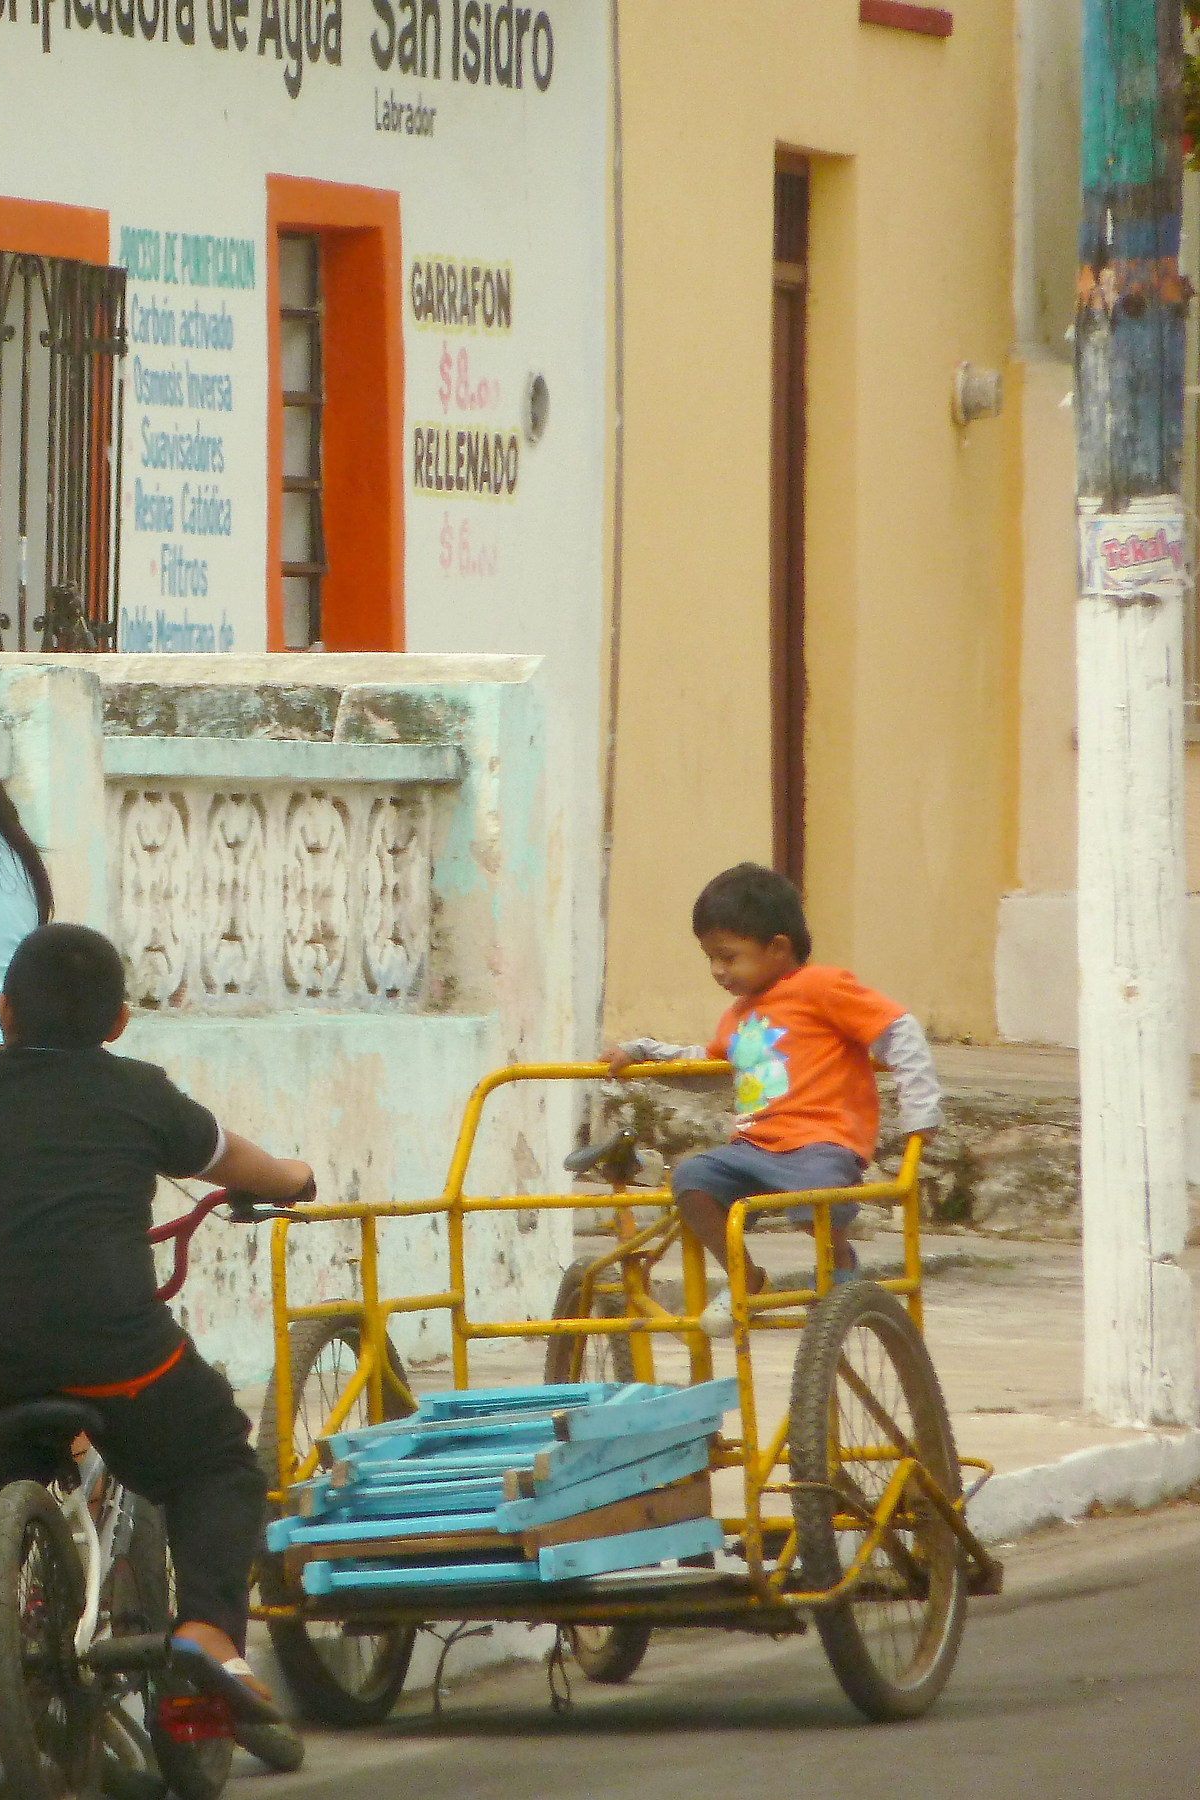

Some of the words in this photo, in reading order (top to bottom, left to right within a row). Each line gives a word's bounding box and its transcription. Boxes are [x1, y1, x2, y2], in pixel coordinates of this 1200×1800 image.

[257, 0, 343, 100] Agua
[370, 0, 441, 80] San
[452, 0, 555, 92] Isidro
[374, 87, 437, 137] Labrador
[411, 260, 512, 328] GARRAFON
[414, 427, 519, 495] RELLENADO
[160, 543, 208, 597] Filtros
